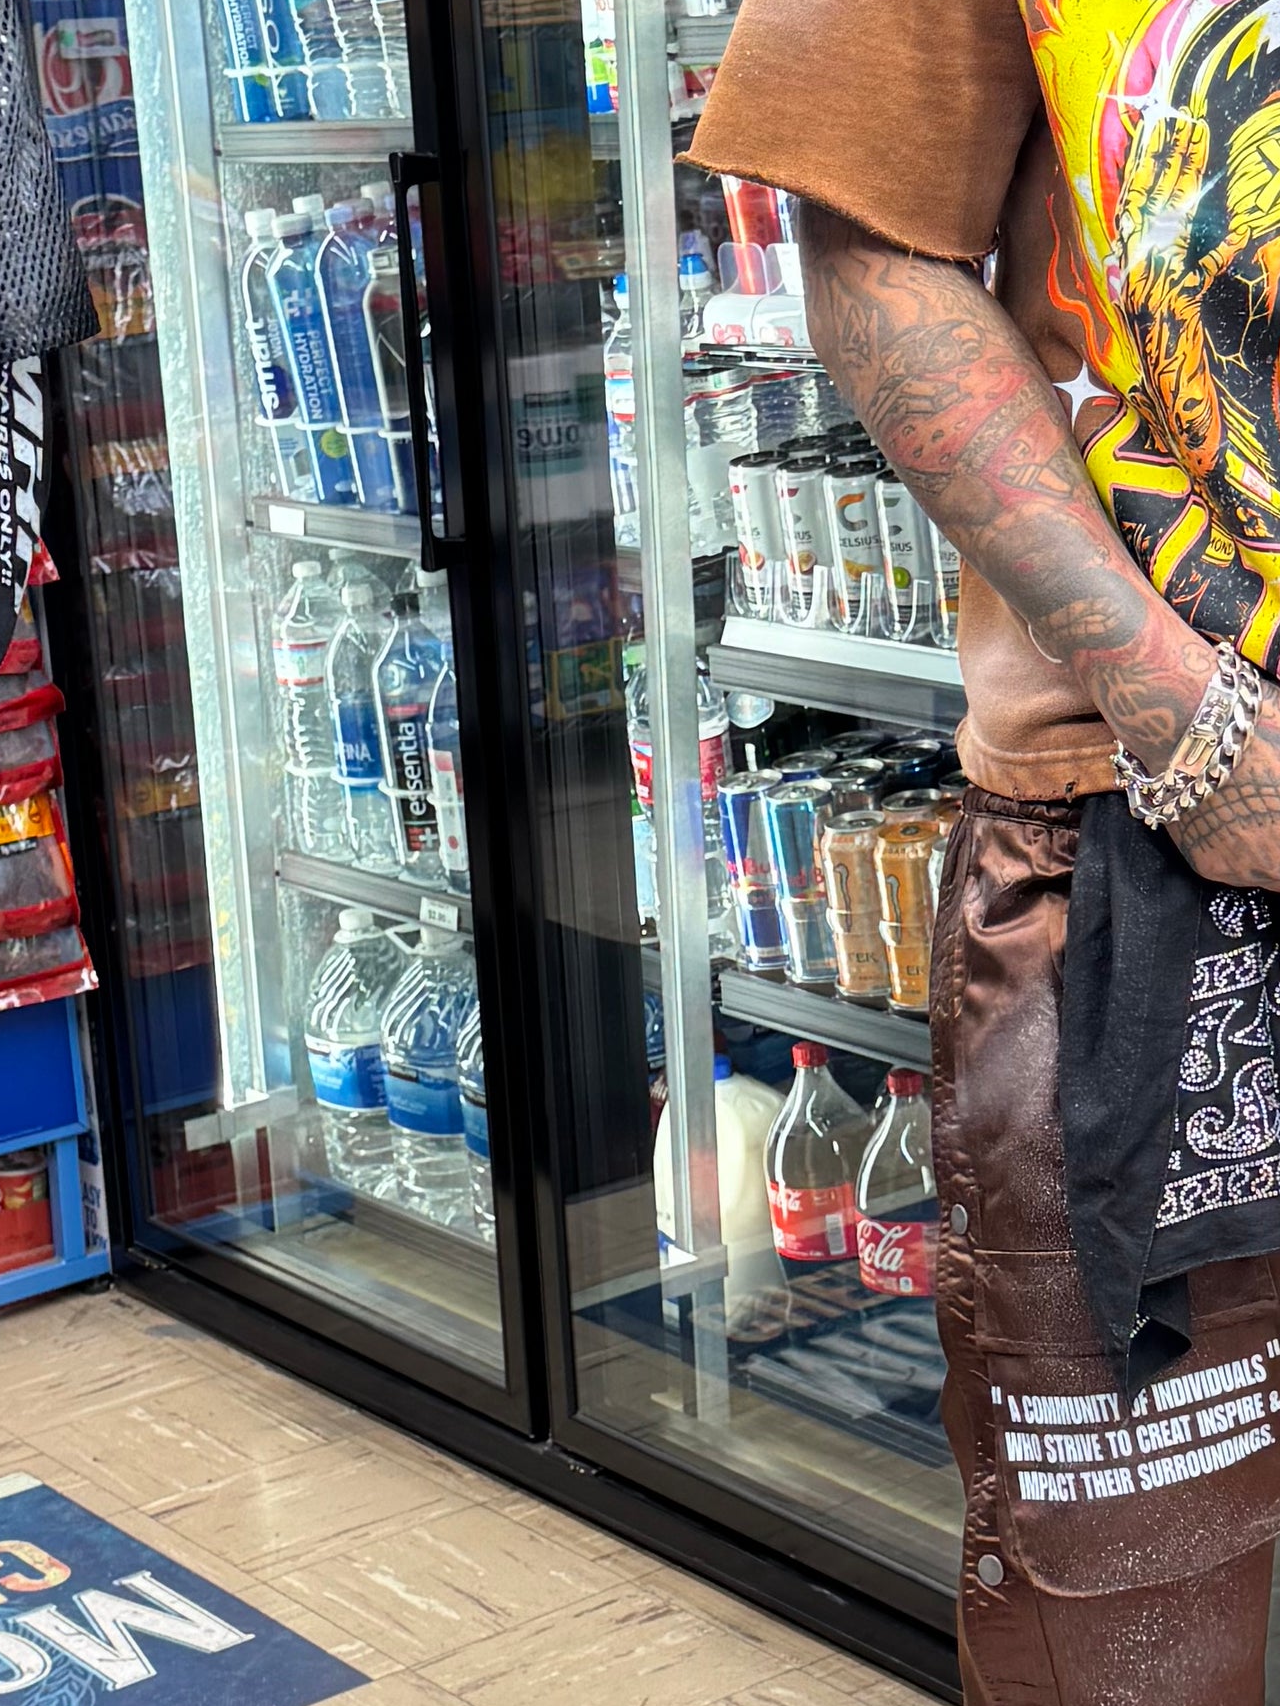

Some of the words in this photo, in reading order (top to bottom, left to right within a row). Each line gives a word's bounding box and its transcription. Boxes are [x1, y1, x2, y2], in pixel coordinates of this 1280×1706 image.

[0, 488, 14, 588] ONLY!!
[1007, 1393, 1022, 1423] A
[1023, 1390, 1121, 1425] COMMUNITY
[1151, 1355, 1268, 1411] INDIVIDUALS
[1005, 1430, 1043, 1463] WHO
[1045, 1432, 1104, 1463] STRIVE
[1108, 1427, 1133, 1458] TO
[1137, 1414, 1192, 1459] CREAT
[1198, 1402, 1266, 1444] INSPIRE
[1018, 1467, 1077, 1503] IMPACT
[1080, 1467, 1133, 1499] THEIR
[1136, 1428, 1277, 1490] SURROUNDINGS.
